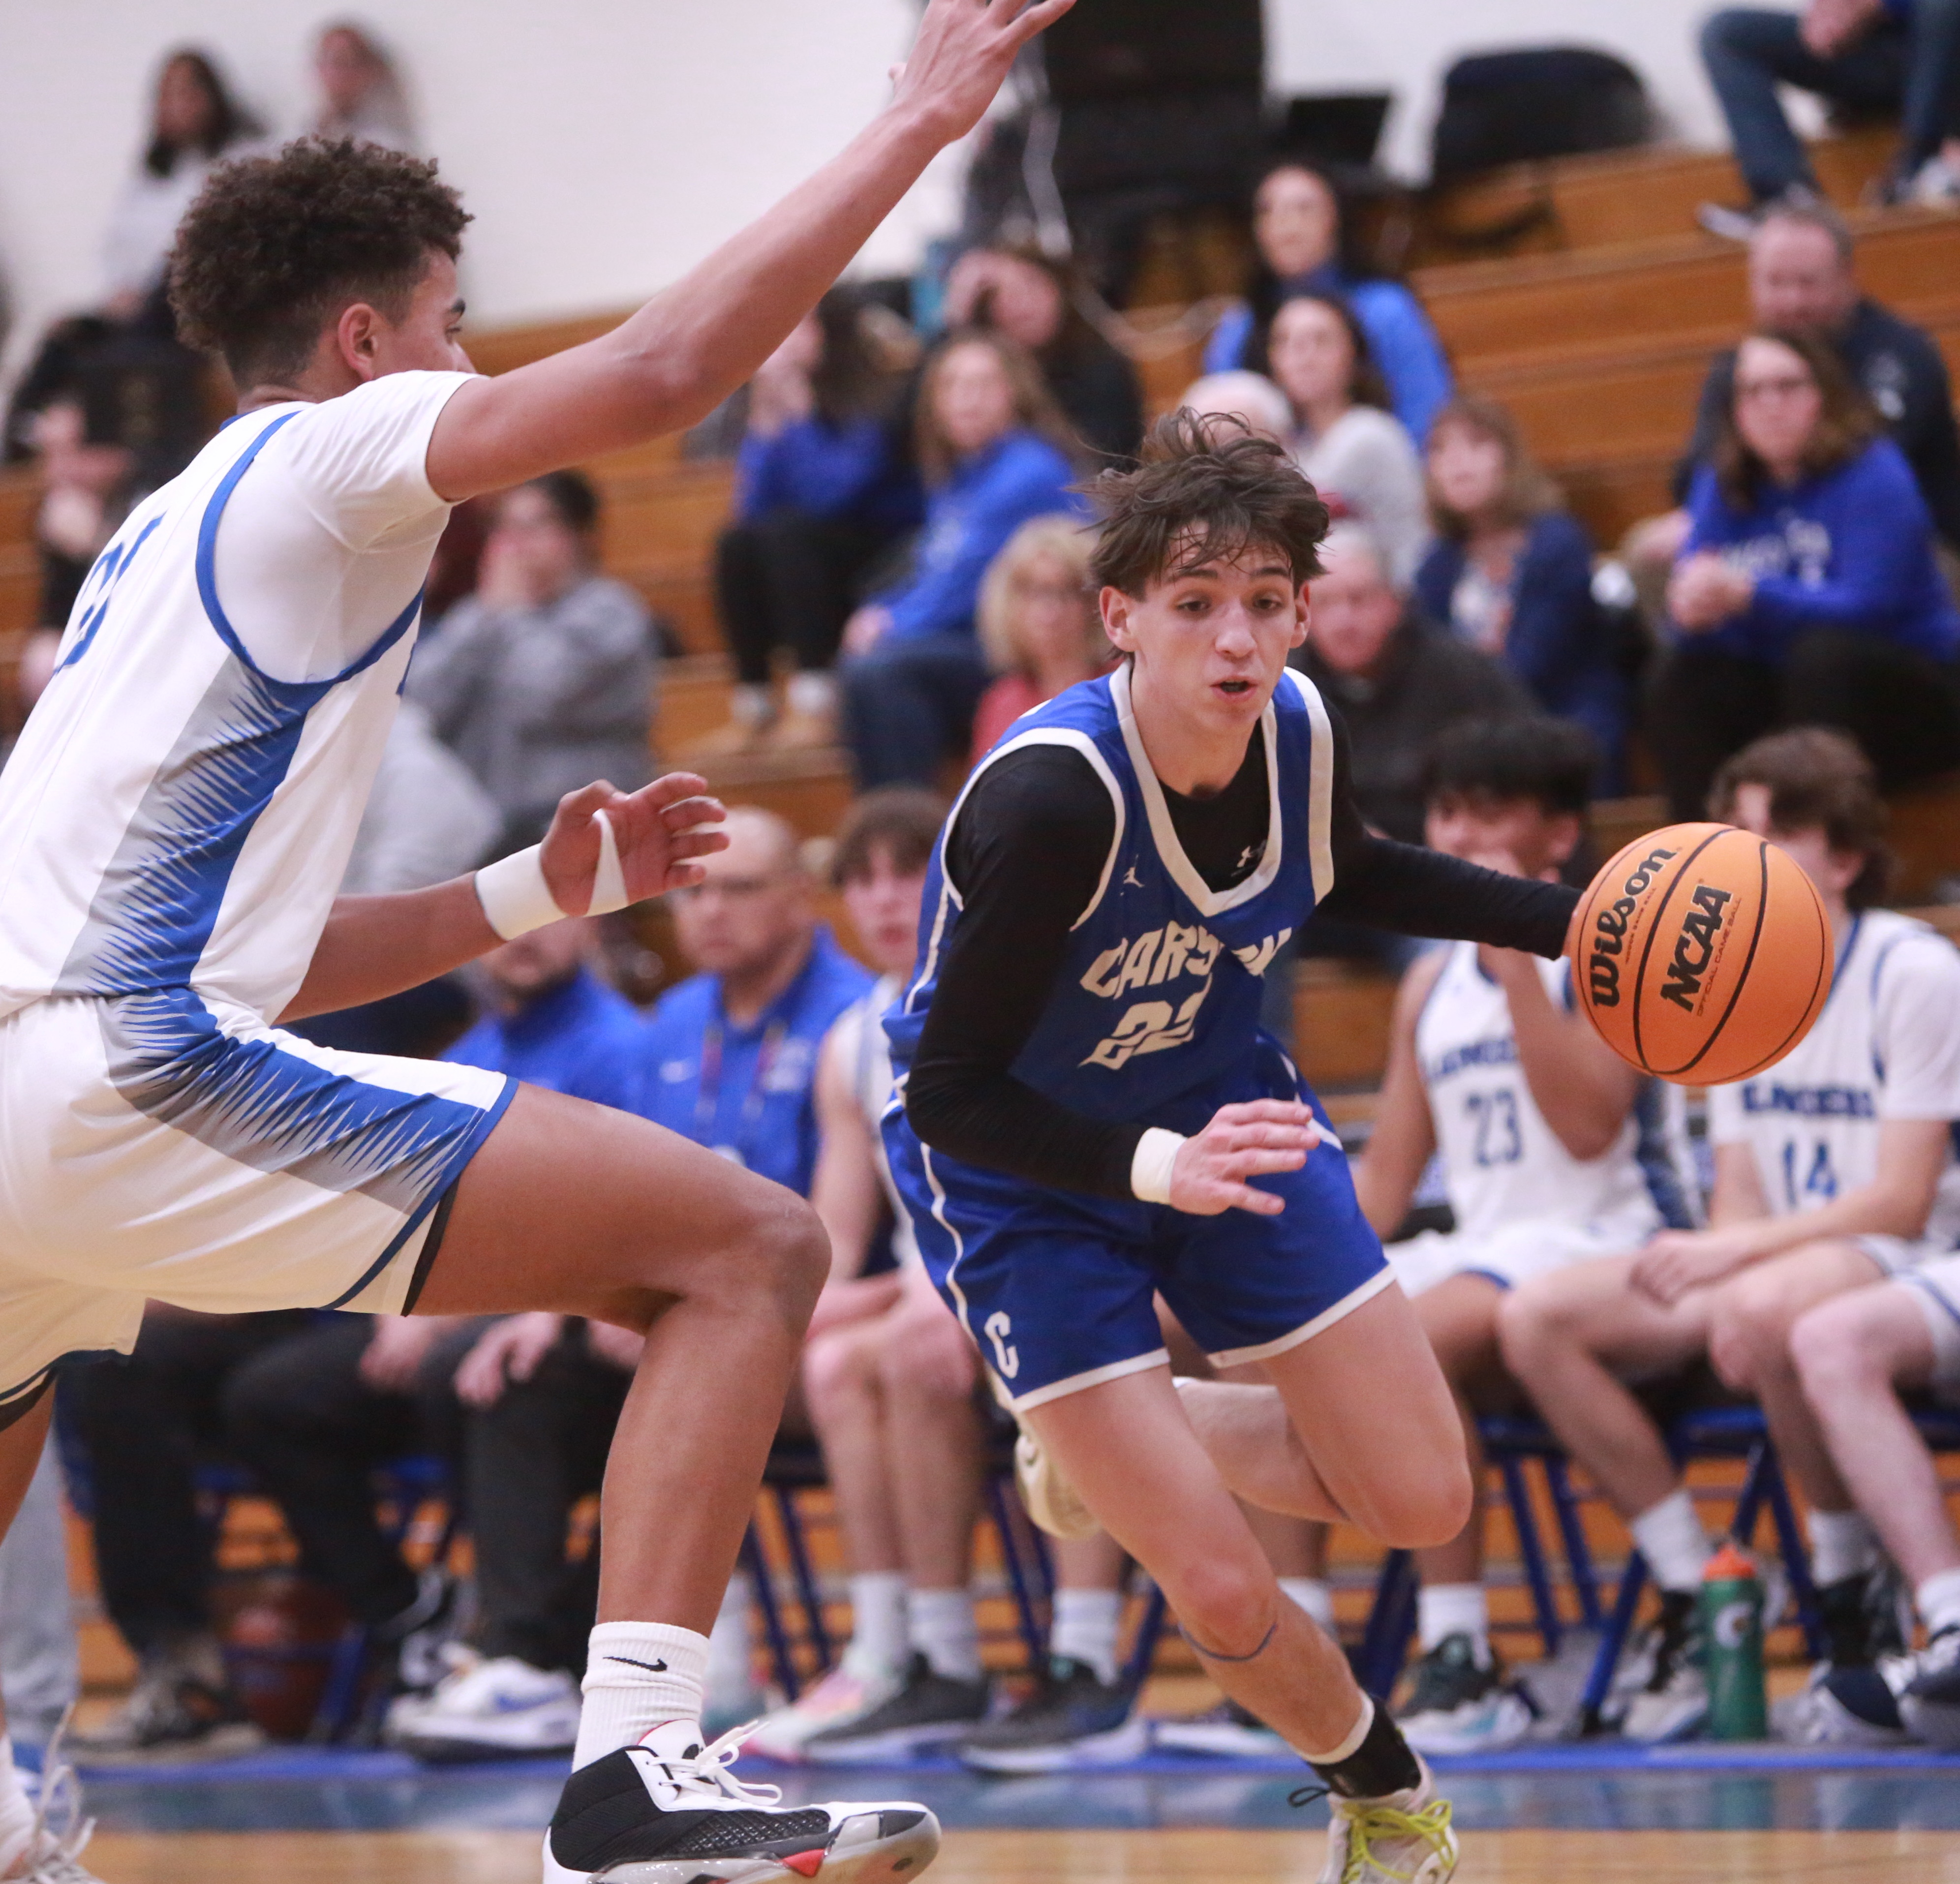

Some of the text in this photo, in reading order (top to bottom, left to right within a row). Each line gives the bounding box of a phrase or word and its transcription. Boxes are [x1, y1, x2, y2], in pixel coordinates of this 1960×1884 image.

[1660, 885, 1733, 1012] NCAA
[1697, 898, 1742, 1017] OFFICIAL GAME BALL
[1782, 1139, 1839, 1209] 14
[984, 1310, 1019, 1379] C
